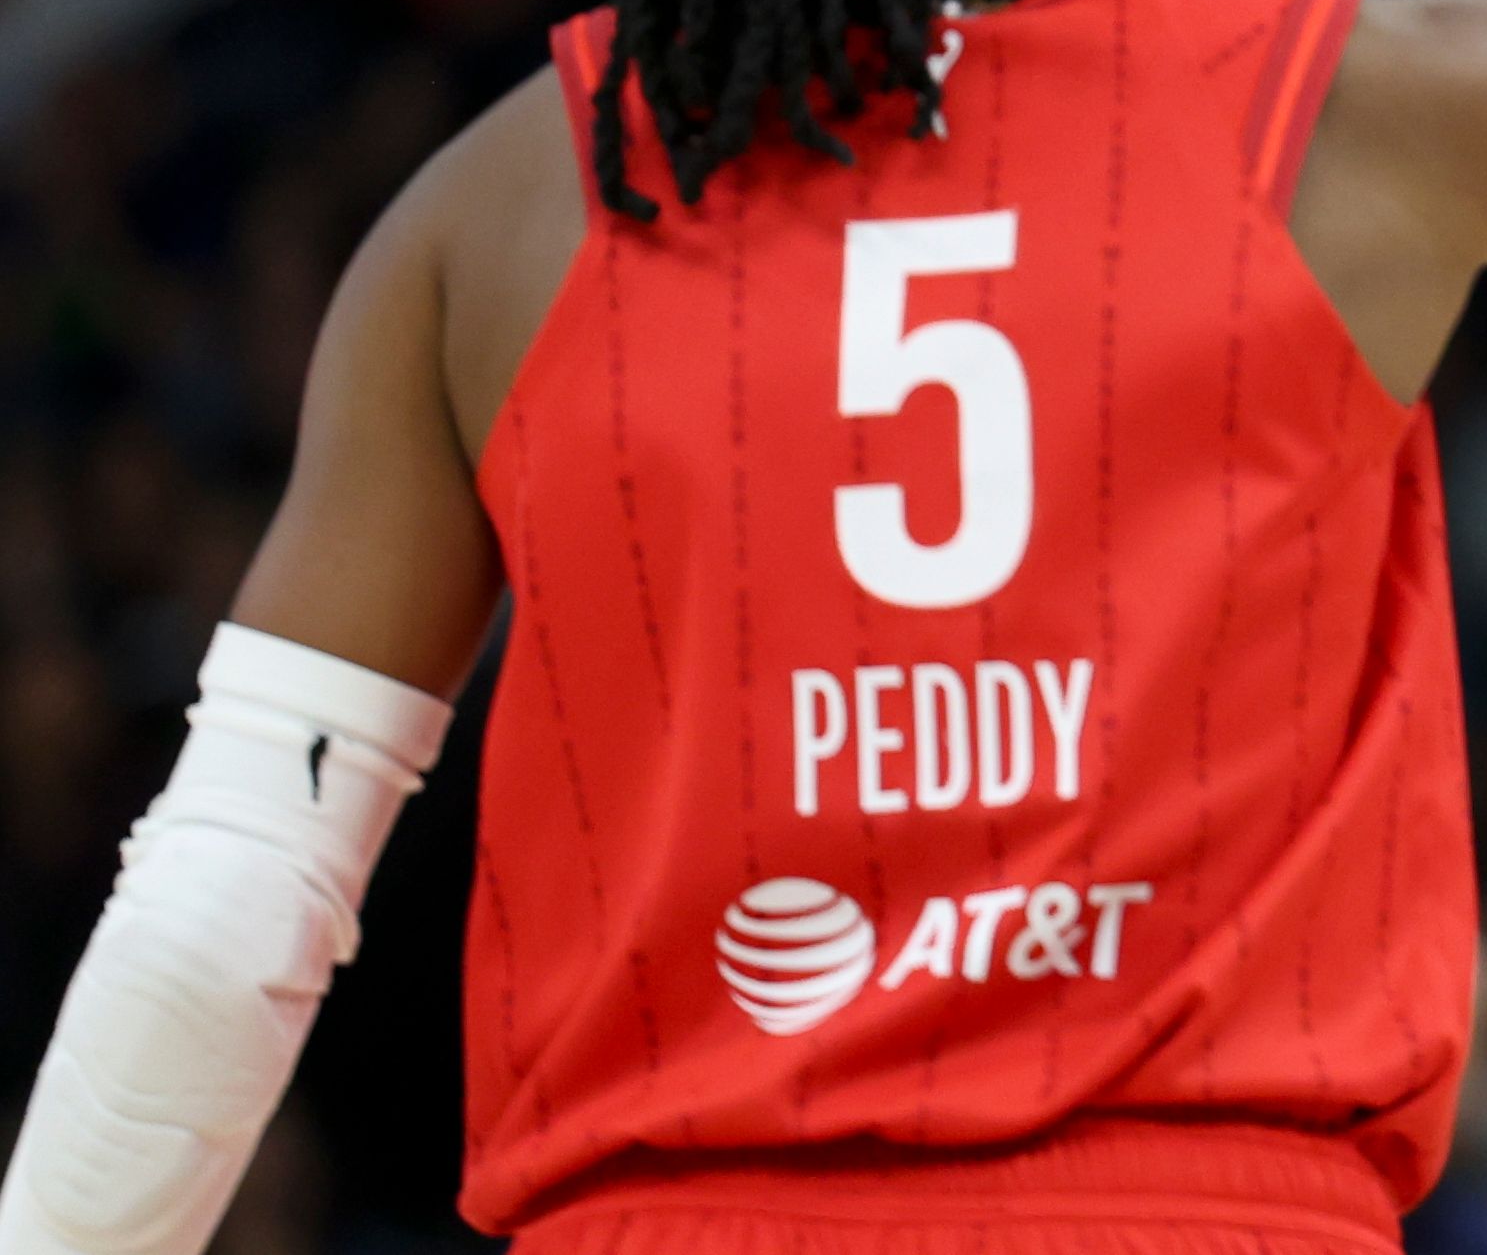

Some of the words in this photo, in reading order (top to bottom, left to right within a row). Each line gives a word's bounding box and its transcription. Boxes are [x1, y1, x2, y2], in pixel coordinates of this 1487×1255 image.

[832, 208, 1036, 610] 5
[790, 656, 1095, 818] PEDDY
[877, 879, 1157, 993] AT&T
